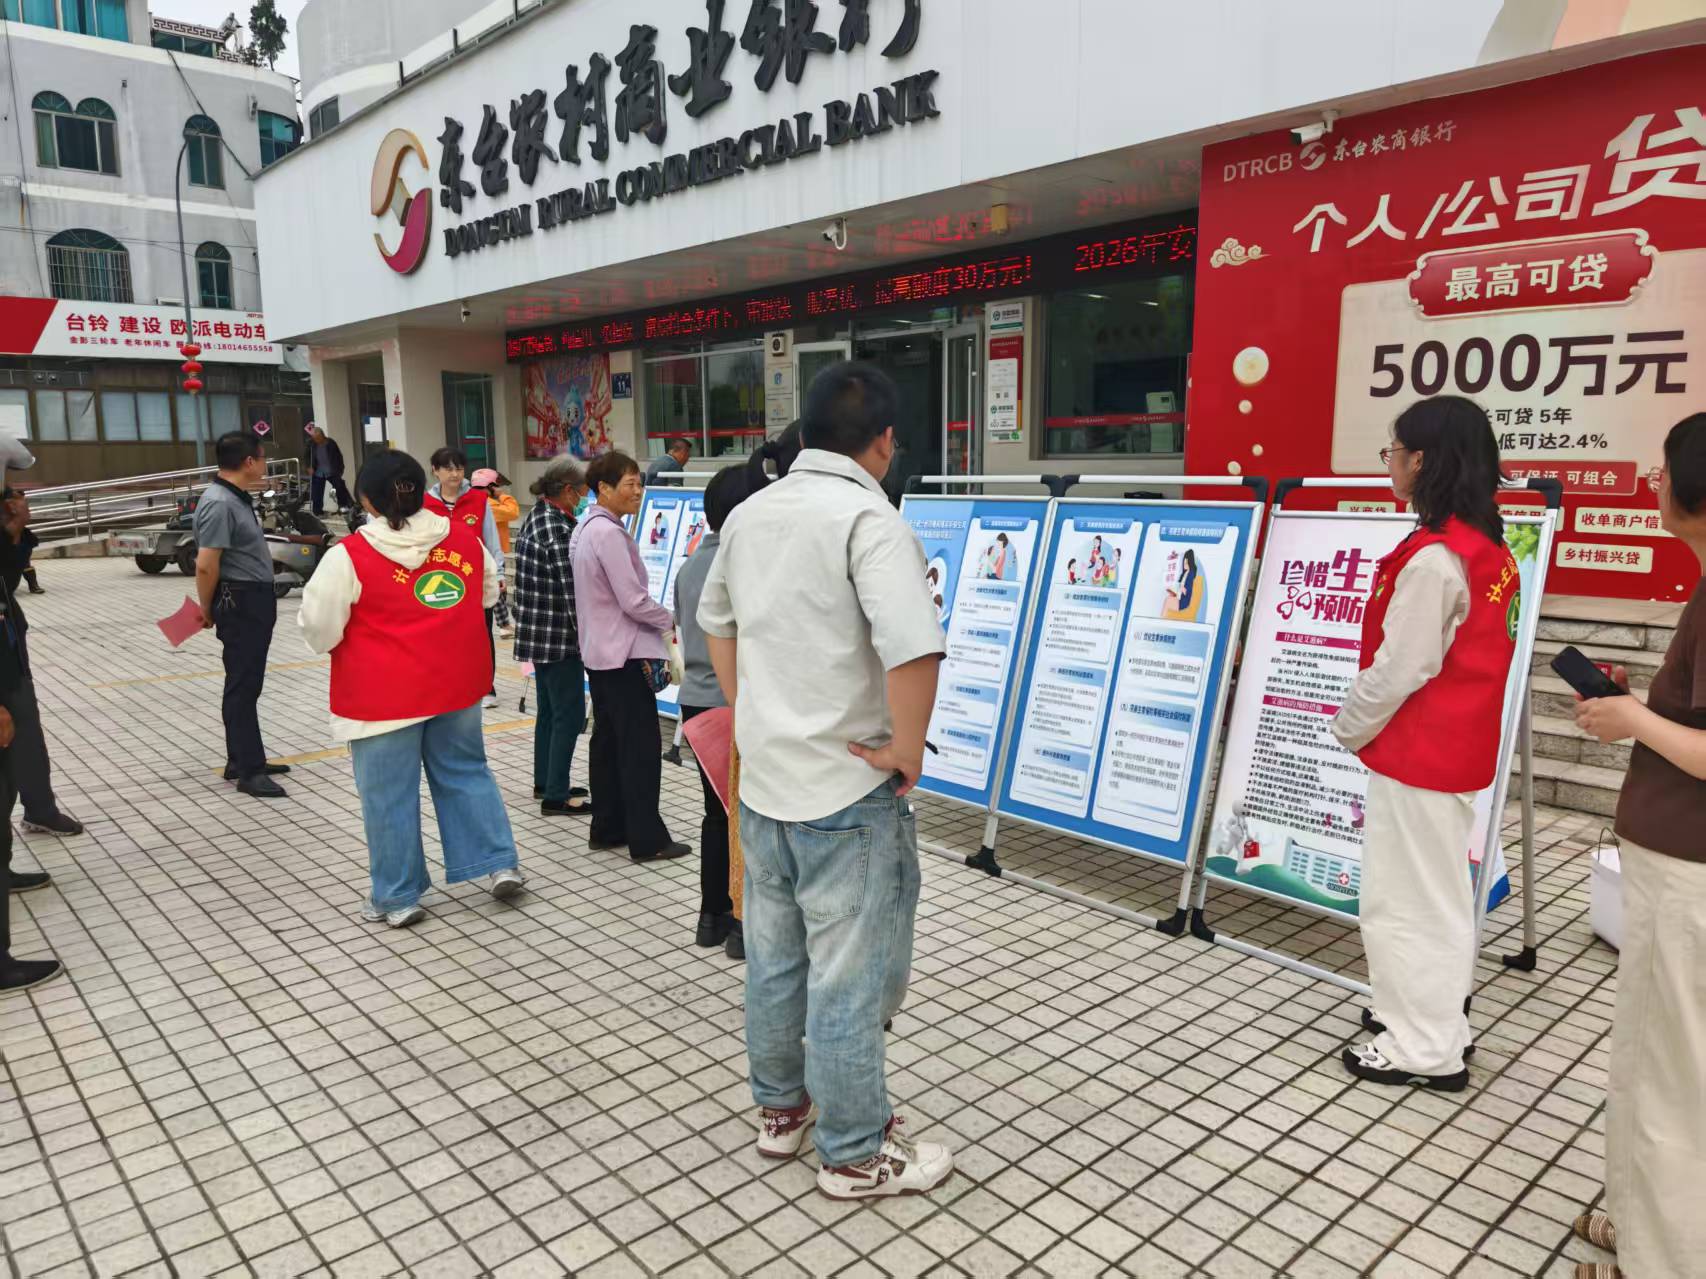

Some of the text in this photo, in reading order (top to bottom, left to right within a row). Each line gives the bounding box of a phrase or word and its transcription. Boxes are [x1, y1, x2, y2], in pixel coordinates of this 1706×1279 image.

[1332, 119, 1458, 163] 东台农商银行
[443, 69, 942, 257] DONGTAI RURAL COMMERCIAL BANK
[1223, 151, 1293, 183] DTRCB
[1444, 253, 1609, 302] 最高可贷
[65, 313, 109, 333] 台铃
[119, 316, 163, 335] 建设
[1369, 329, 1690, 399] 5000万元
[1539, 407, 1573, 425] 5年
[1498, 432, 1609, 450] 低可达2.4%
[1566, 470, 1619, 487] 可组合
[1581, 512, 1660, 529] 收单商户信
[1279, 548, 1380, 593] 珍惜生
[1564, 548, 1641, 566] 乡村振兴贷
